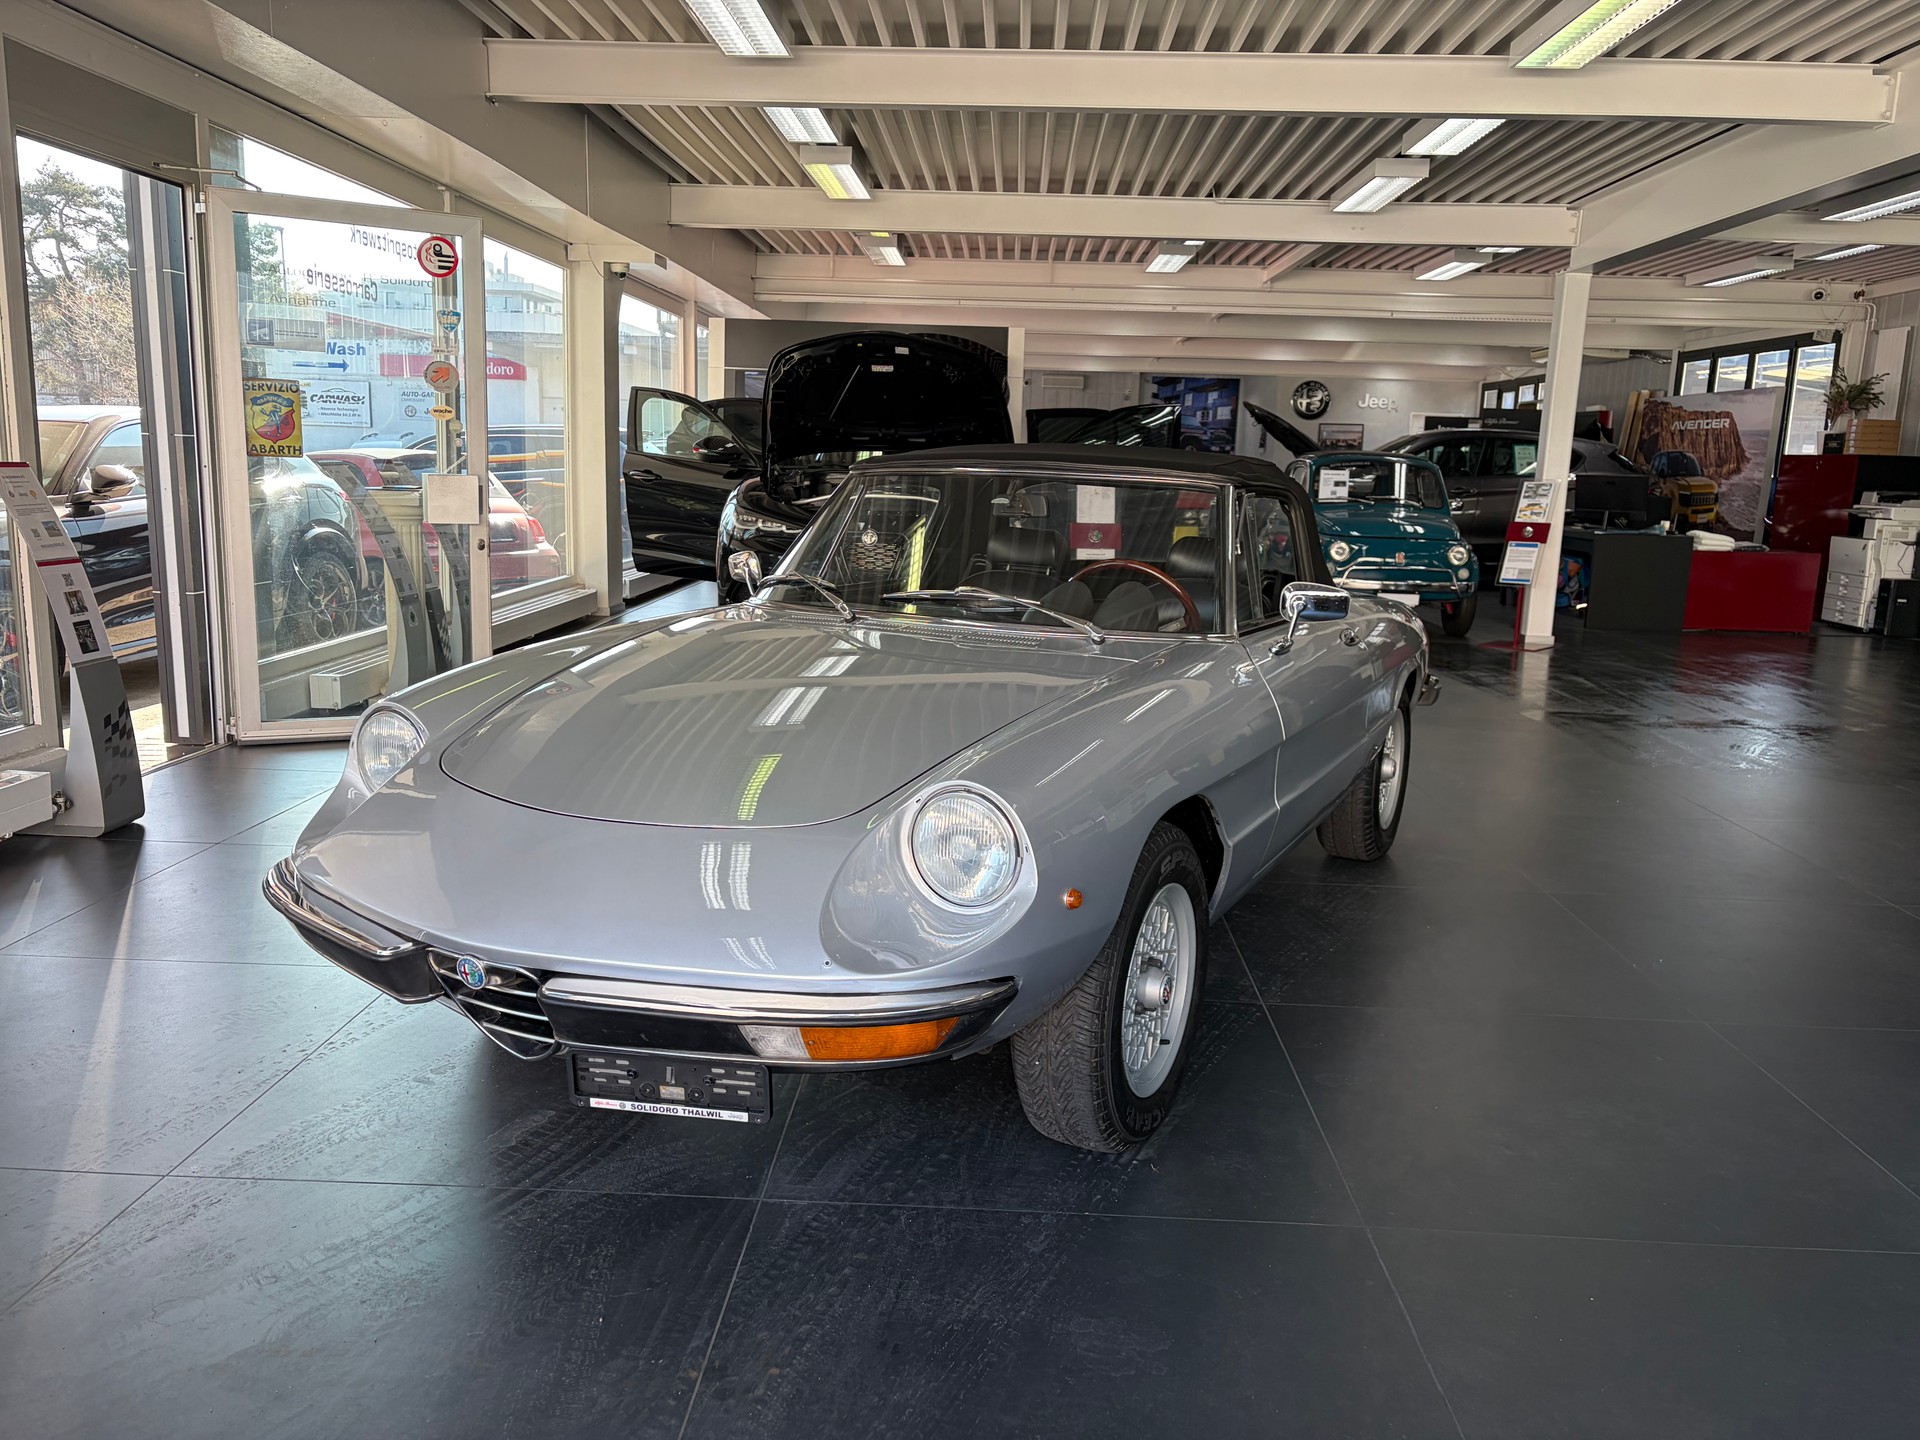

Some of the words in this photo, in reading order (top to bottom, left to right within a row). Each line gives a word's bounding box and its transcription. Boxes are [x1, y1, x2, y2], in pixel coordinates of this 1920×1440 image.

[270, 293, 337, 308] Annahme
[486, 361, 514, 376] doro
[244, 382, 299, 393] SERVIZIO
[310, 393, 366, 406] CARWASH
[1358, 393, 1398, 412] Jeep
[1671, 418, 1731, 430] AVENGER
[250, 443, 303, 455] ABARTH
[630, 1103, 679, 1114] SOLIDORO
[681, 1108, 724, 1119] THALWIL
